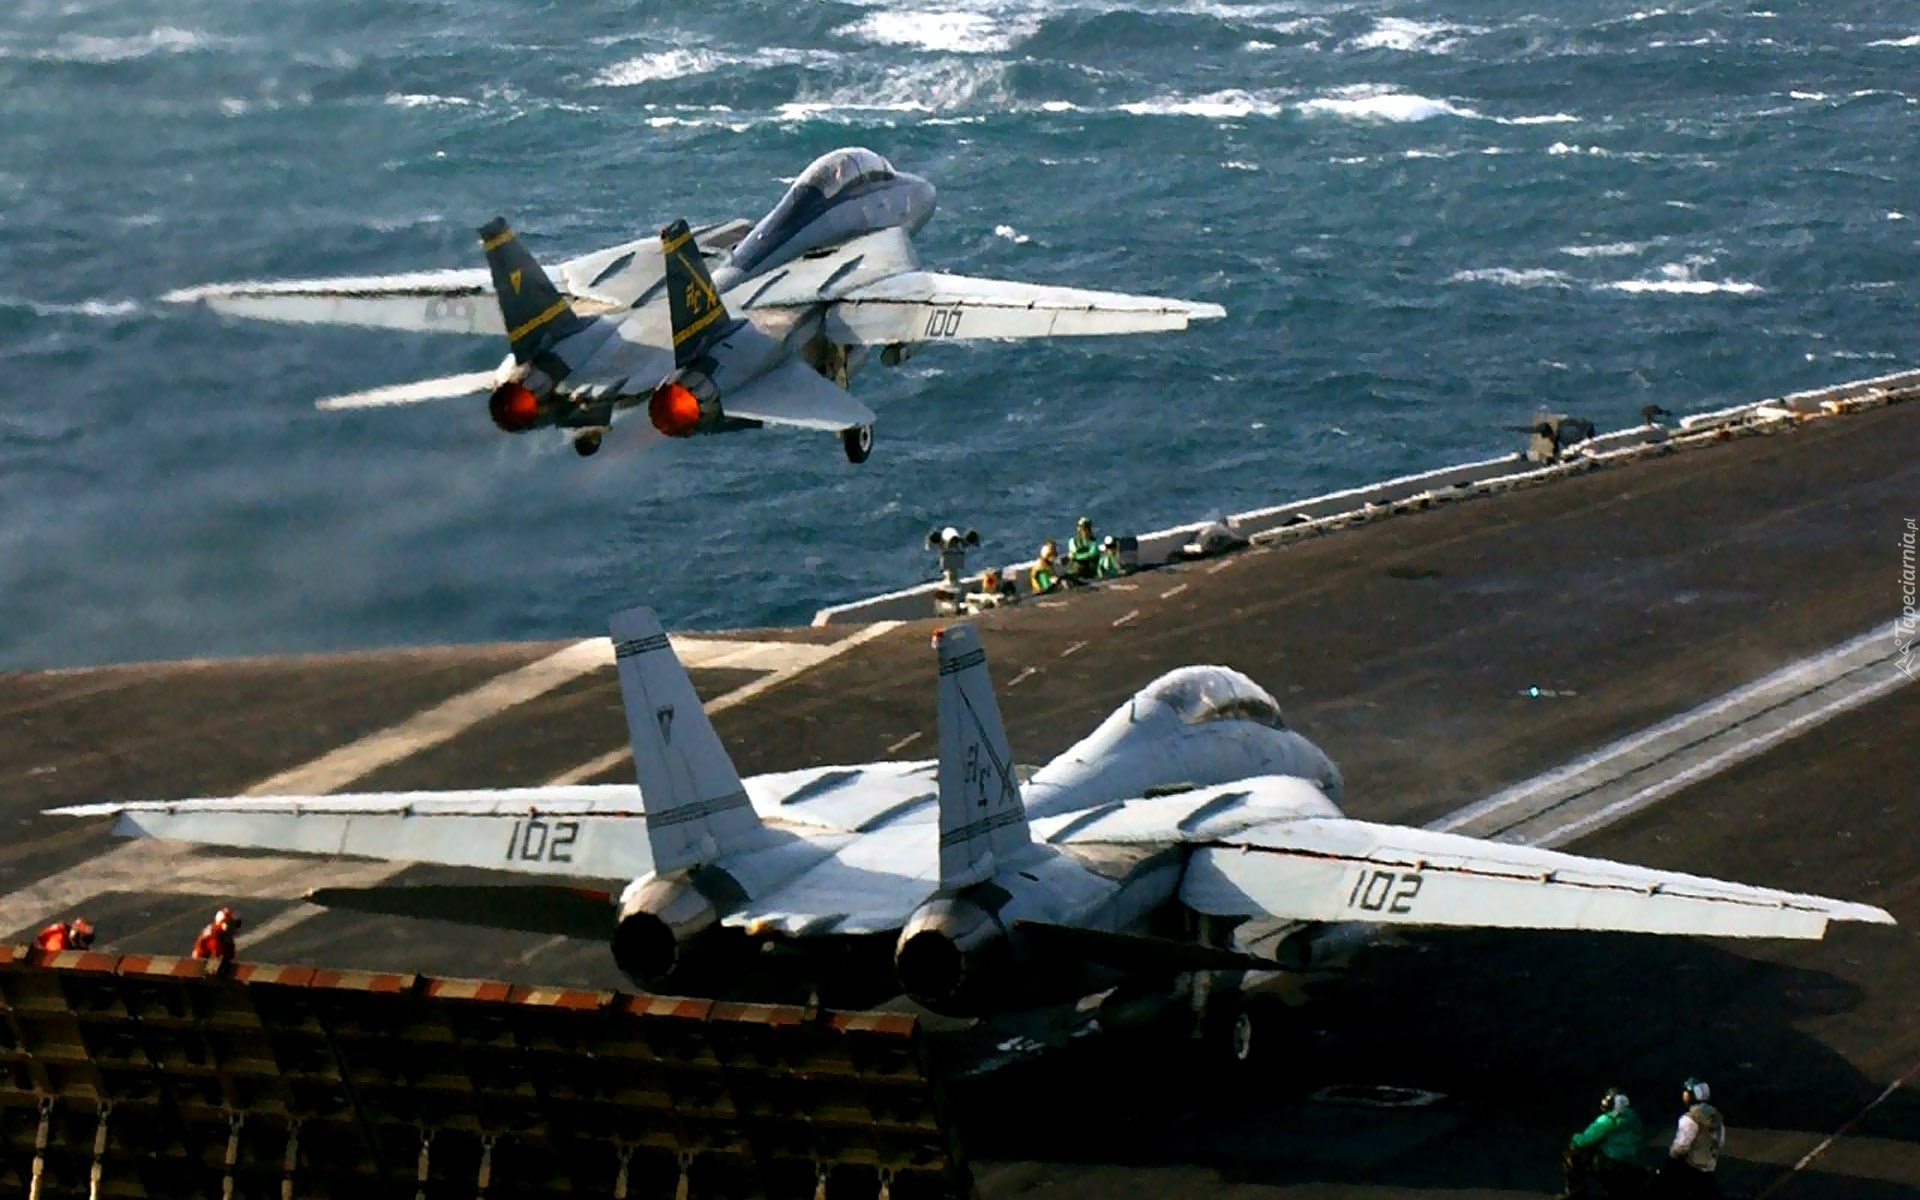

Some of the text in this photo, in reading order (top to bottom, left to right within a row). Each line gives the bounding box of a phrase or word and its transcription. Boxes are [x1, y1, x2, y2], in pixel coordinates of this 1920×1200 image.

[923, 309, 963, 337] 100
[506, 820, 579, 863] 102
[1348, 869, 1424, 914] 102
